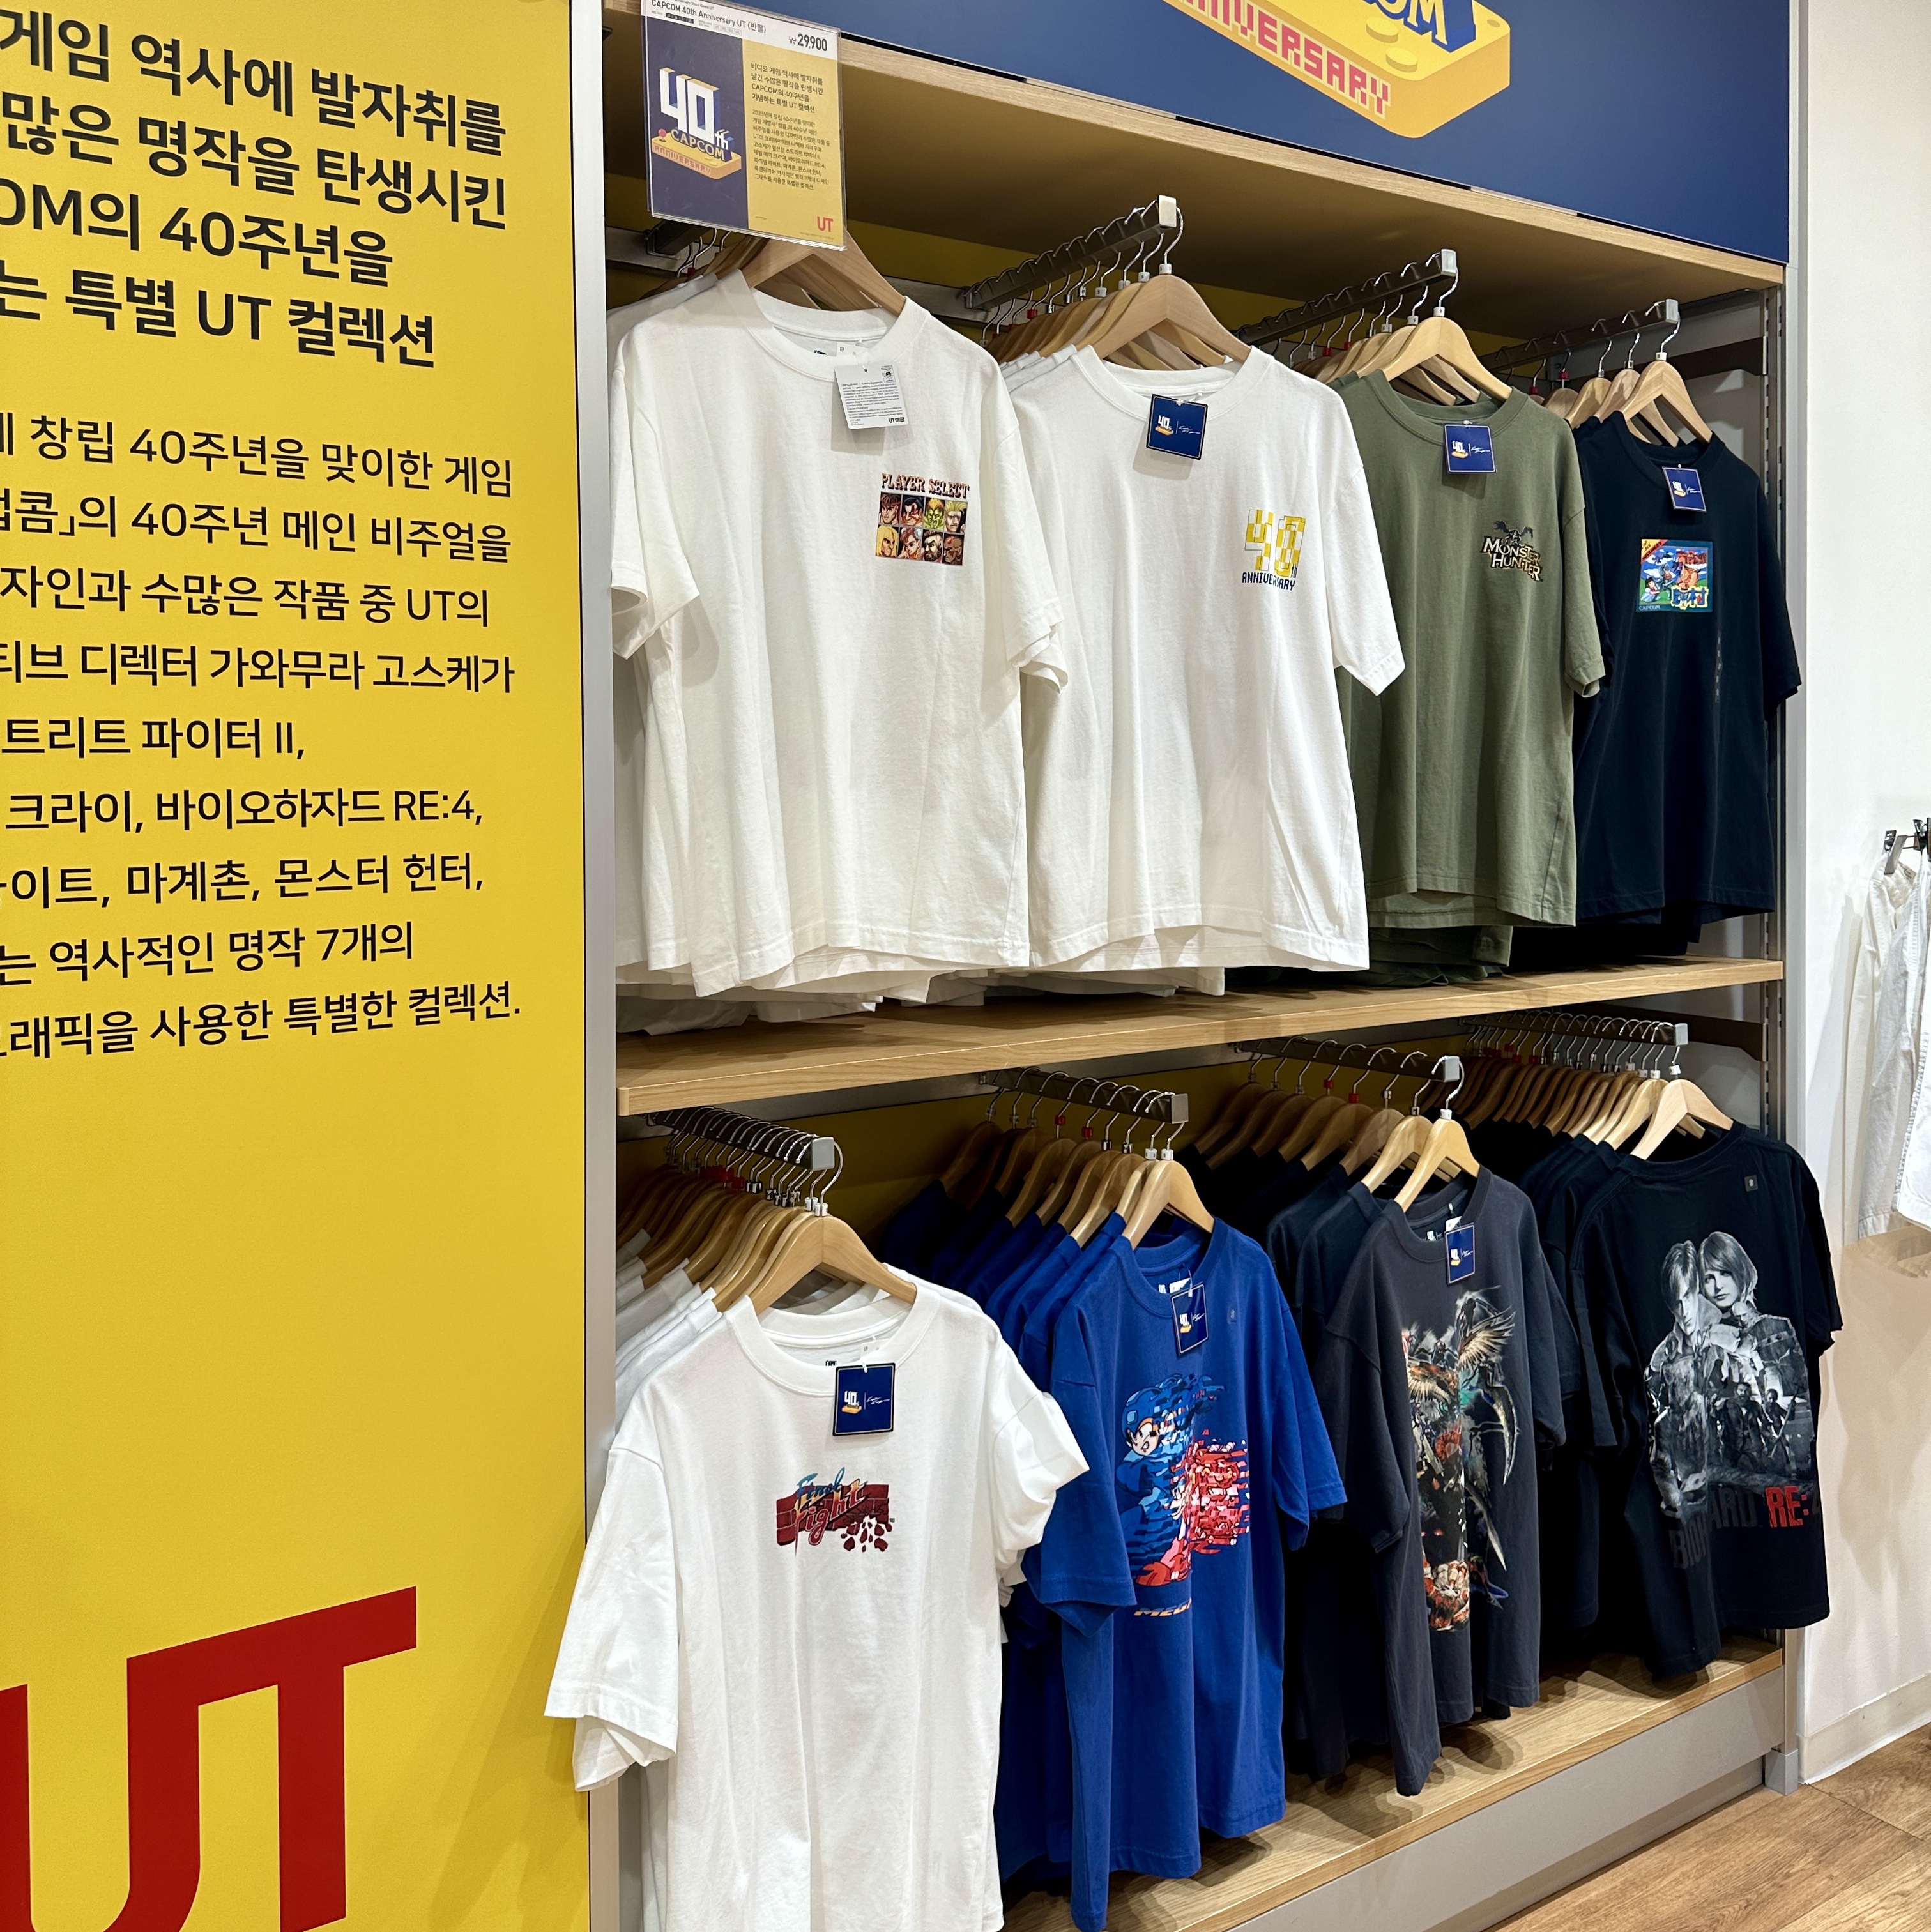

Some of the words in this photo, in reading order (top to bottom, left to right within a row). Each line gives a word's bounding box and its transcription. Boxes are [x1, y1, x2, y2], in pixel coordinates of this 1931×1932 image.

[652, 0, 680, 12] CAPCOM
[682, 6, 697, 16] 40th
[698, 10, 735, 27] Anniversary
[737, 19, 746, 28] UT
[798, 33, 827, 51] 29,900
[1185, 0, 1391, 119] IVERSARY
[0, 9, 109, 82] 게임
[131, 34, 293, 117] 역사에
[312, 68, 506, 156] 발자취를
[752, 83, 783, 96] CAPCOM의
[2, 91, 119, 165] 많은
[139, 116, 300, 196] 명작을
[317, 148, 505, 230] 탄생시킨
[654, 145, 712, 175] ANNIVERSARY
[671, 129, 726, 162] CAPCOM
[160, 207, 393, 287] 40주년을
[817, 216, 834, 232] UT
[65, 269, 176, 338] 특별
[198, 289, 271, 340] UT
[288, 298, 434, 368] 컬렉션
[30, 415, 113, 464] 창립
[130, 429, 309, 480] 40주년을
[322, 444, 433, 490] 맞이한
[445, 457, 511, 498] 게임
[882, 473, 925, 492] PLAYER
[929, 479, 970, 498] SELECT
[0, 488, 116, 538] 콤」의
[131, 502, 268, 547] 40주년
[283, 510, 356, 552] 메인
[371, 517, 511, 563] 비주얼을
[1481, 536, 1539, 566] MONSTER
[1242, 572, 1295, 591] ANNIVERSARY
[1491, 553, 1542, 581] HUNTER
[0, 565, 132, 612] 자인과
[141, 573, 263, 617] 수많은
[273, 579, 349, 621] 작품
[360, 584, 396, 623] 중
[407, 589, 488, 627] UT의
[81, 643, 197, 687] 디렉터
[210, 647, 365, 690] 가와무라
[373, 655, 515, 694] 고스케가
[1, 717, 131, 759] 트리트
[142, 717, 261, 759] 파이터
[276, 722, 304, 760] II,
[5, 790, 143, 833] 크라이,
[156, 787, 385, 831] 바이오하자드
[394, 790, 482, 825] RE:4,
[0, 866, 110, 909] 이트,
[128, 860, 259, 904] 마계촌,
[275, 855, 388, 898] 몬스터
[403, 852, 483, 892] 헌터,
[50, 932, 213, 982] 역사적인
[229, 927, 305, 971] 명작
[316, 921, 412, 962] 7개의
[0, 1010, 138, 1059] 래픽을
[149, 1000, 273, 1047] 사용한
[284, 989, 397, 1036] 특별한
[409, 980, 520, 1026] 컬렉션.
[0, 1586, 416, 1932] UT
